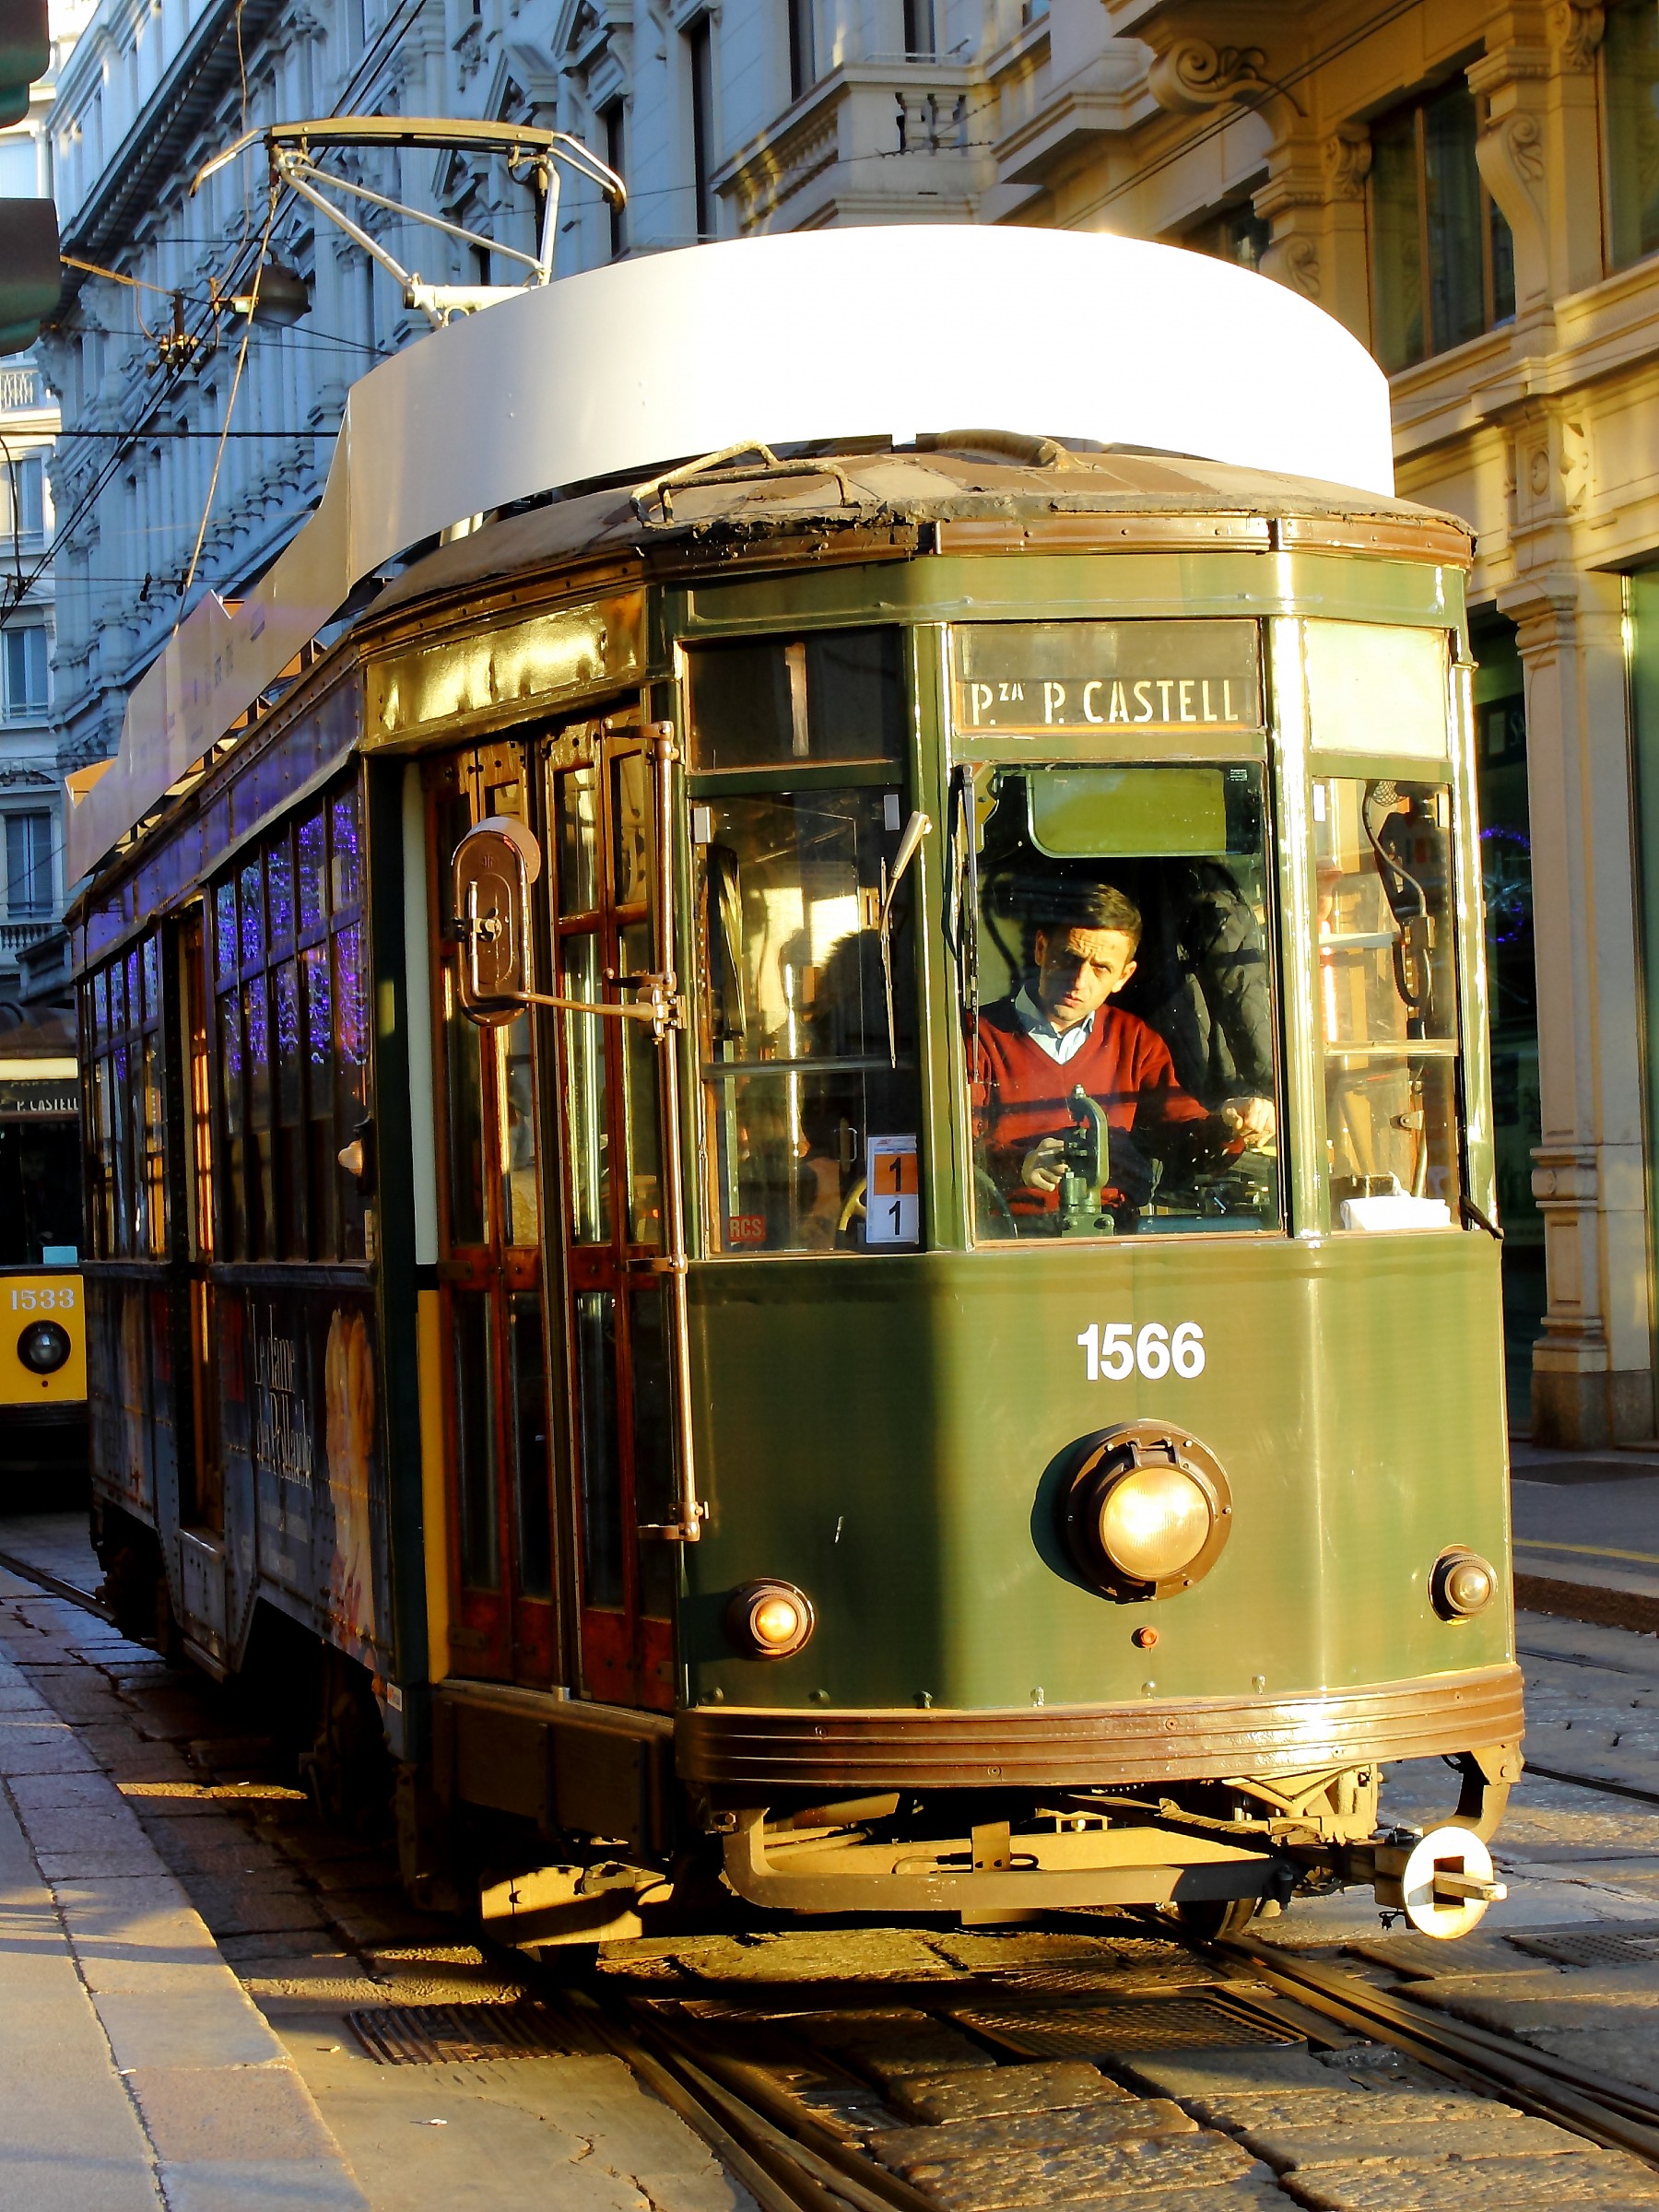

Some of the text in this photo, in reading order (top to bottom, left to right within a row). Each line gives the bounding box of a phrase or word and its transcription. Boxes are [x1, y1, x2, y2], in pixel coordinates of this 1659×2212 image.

[1082, 679, 1239, 724] CASTELL
[888, 1157, 901, 1193] 1
[729, 1218, 762, 1238] RCS
[888, 1200, 901, 1236] 1
[11, 1288, 75, 1311] 1533
[1077, 1321, 1207, 1382] 1566
